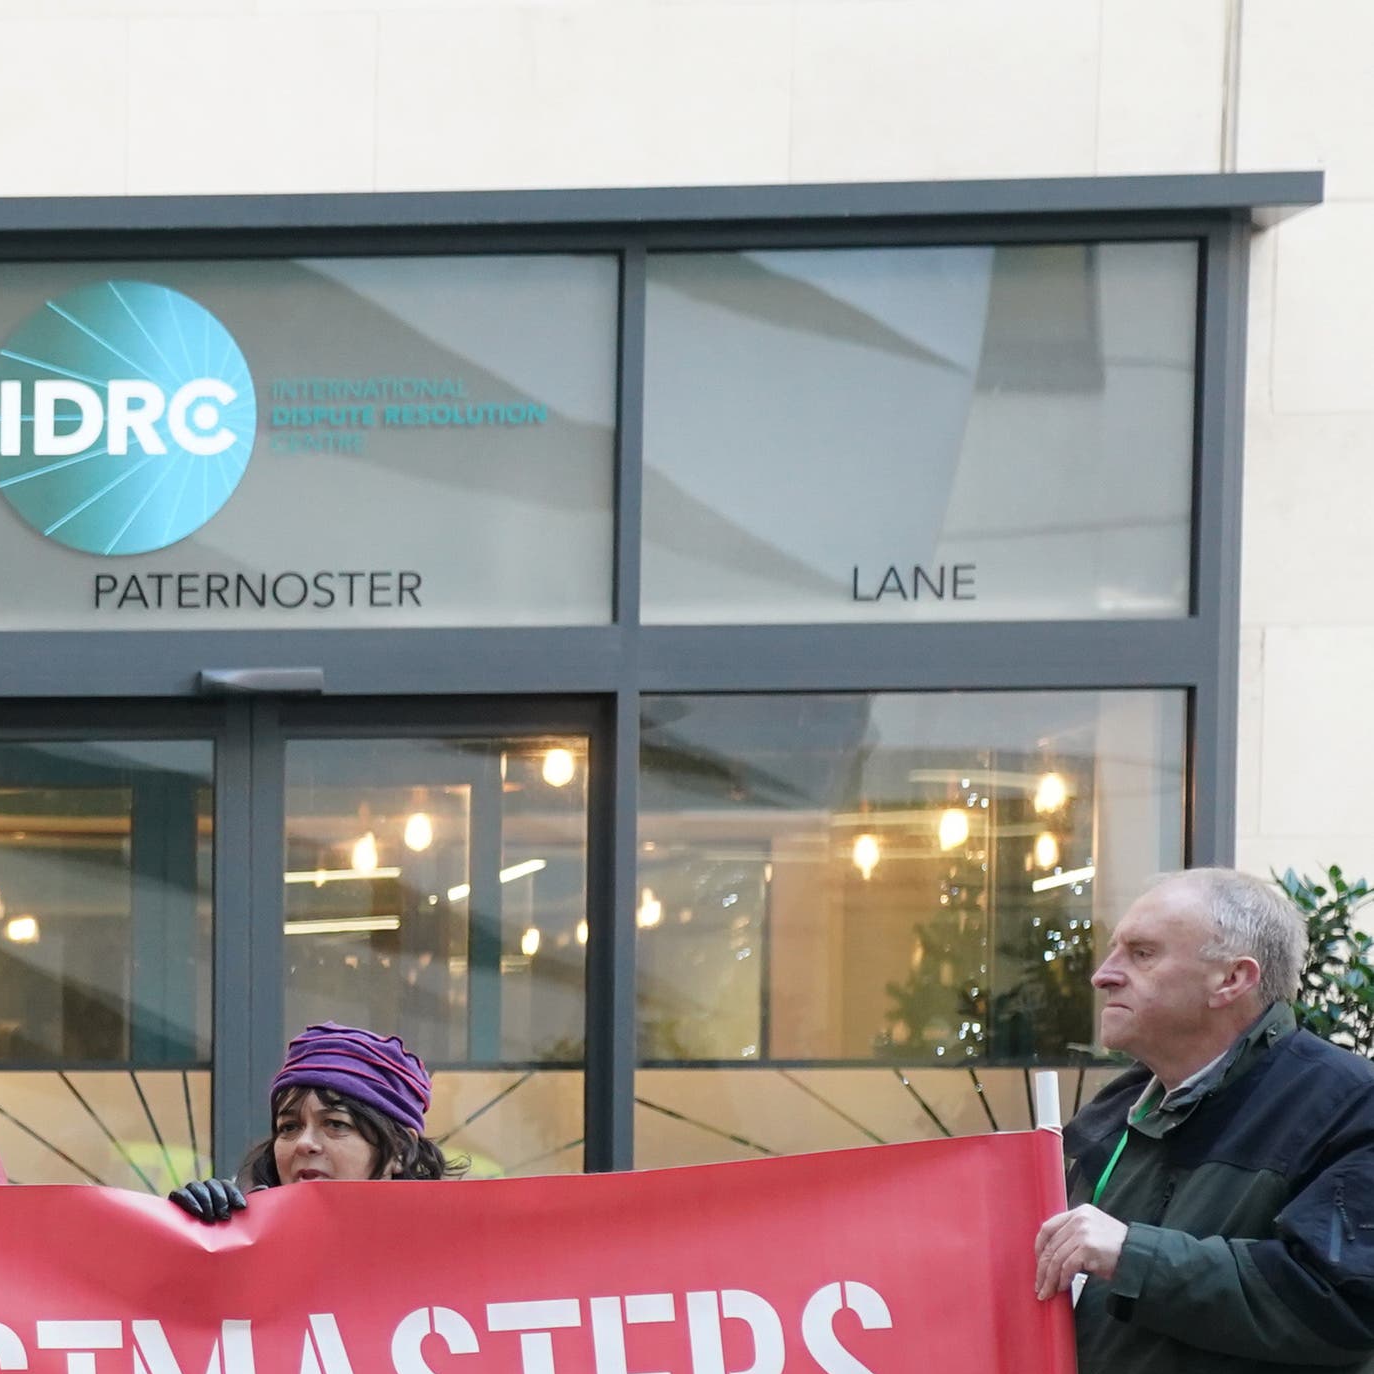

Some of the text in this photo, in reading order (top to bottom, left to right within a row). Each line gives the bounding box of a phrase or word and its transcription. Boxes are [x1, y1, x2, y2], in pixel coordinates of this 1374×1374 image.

[271, 377, 466, 400] INTERNATIONAL
[0, 377, 238, 456] IDRC
[271, 402, 548, 427] DISPUTE RESOLUTION
[94, 571, 423, 609] PATERNOSTER
[852, 564, 976, 601] LANE
